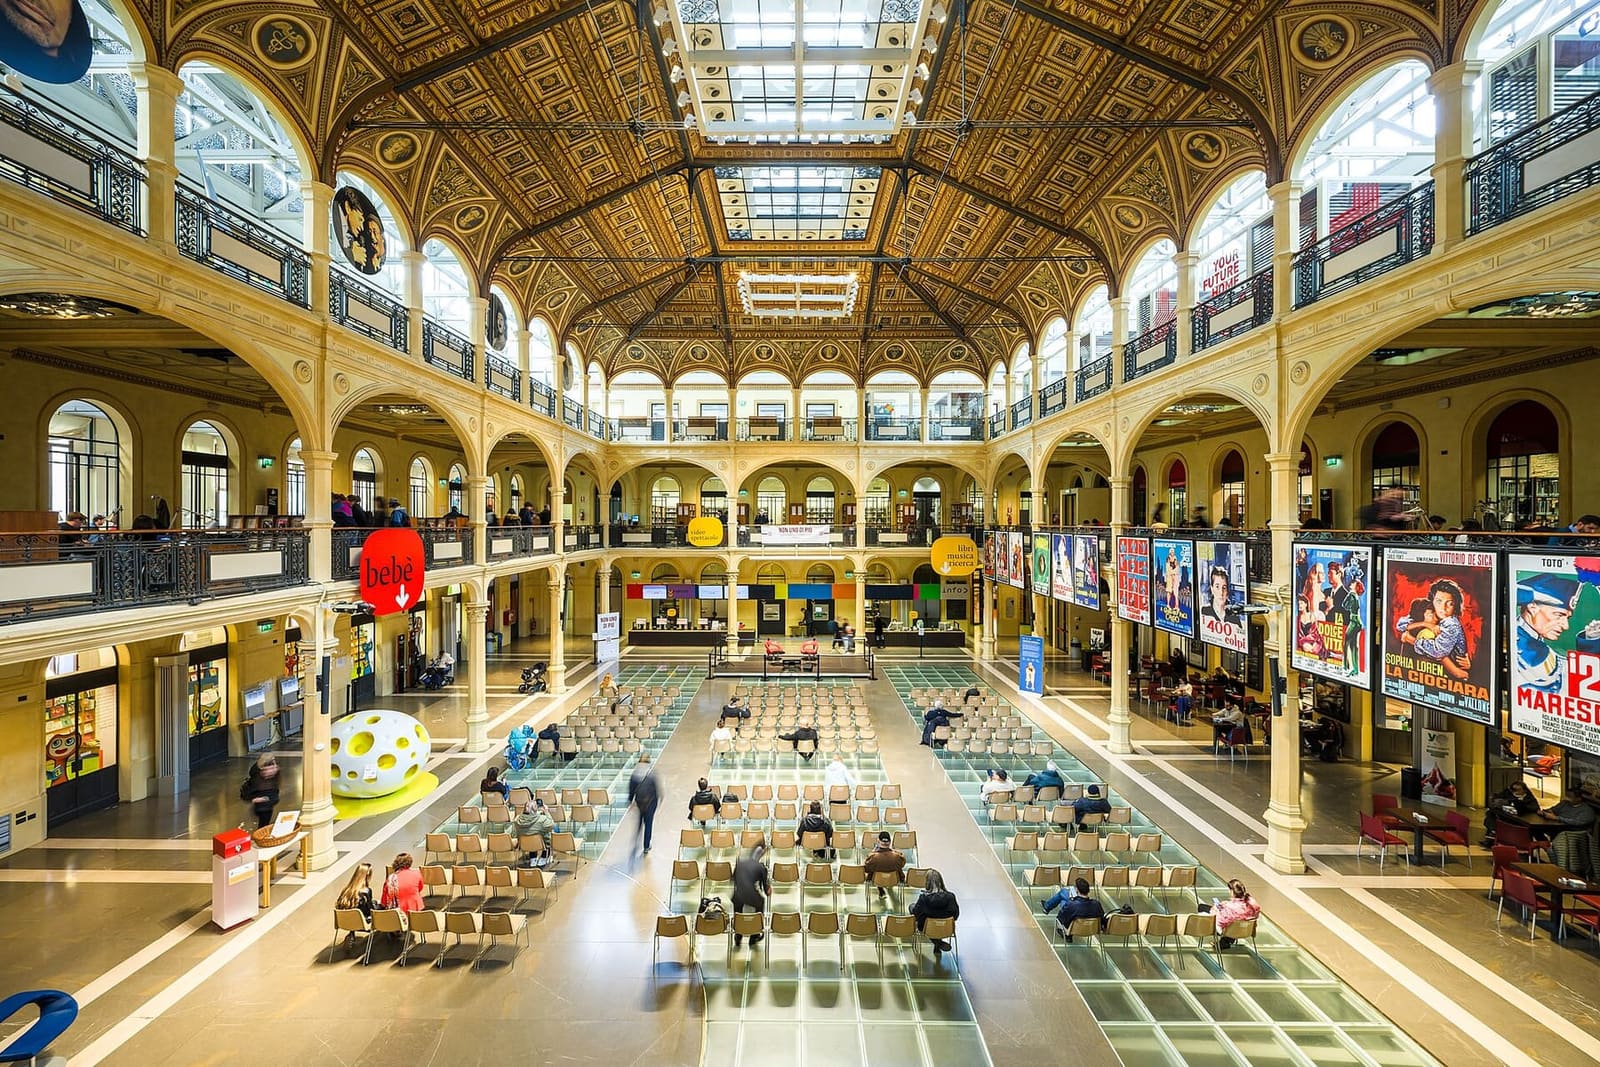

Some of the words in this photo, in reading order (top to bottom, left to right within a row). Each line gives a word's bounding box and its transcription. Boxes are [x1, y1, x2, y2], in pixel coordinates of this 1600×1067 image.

[1213, 249, 1239, 272] YOUR
[1203, 261, 1239, 291] FUTURE
[947, 552, 974, 560] musica
[958, 544, 974, 552] libri
[1440, 552, 1465, 565] VITTORIO
[1468, 553, 1476, 566] DE
[1477, 554, 1493, 567] SICA
[365, 555, 413, 588] bebè
[1335, 612, 1343, 625] LA
[1206, 620, 1232, 636] 400
[1318, 623, 1343, 640] DOLCE
[1225, 634, 1246, 650] colpi
[1324, 636, 1343, 653] VITA
[1386, 653, 1414, 669] SOPHIA
[1386, 665, 1403, 678] LA
[1408, 671, 1489, 701] CIOCIARA
[1571, 740, 1599, 752] CORBUCCI
